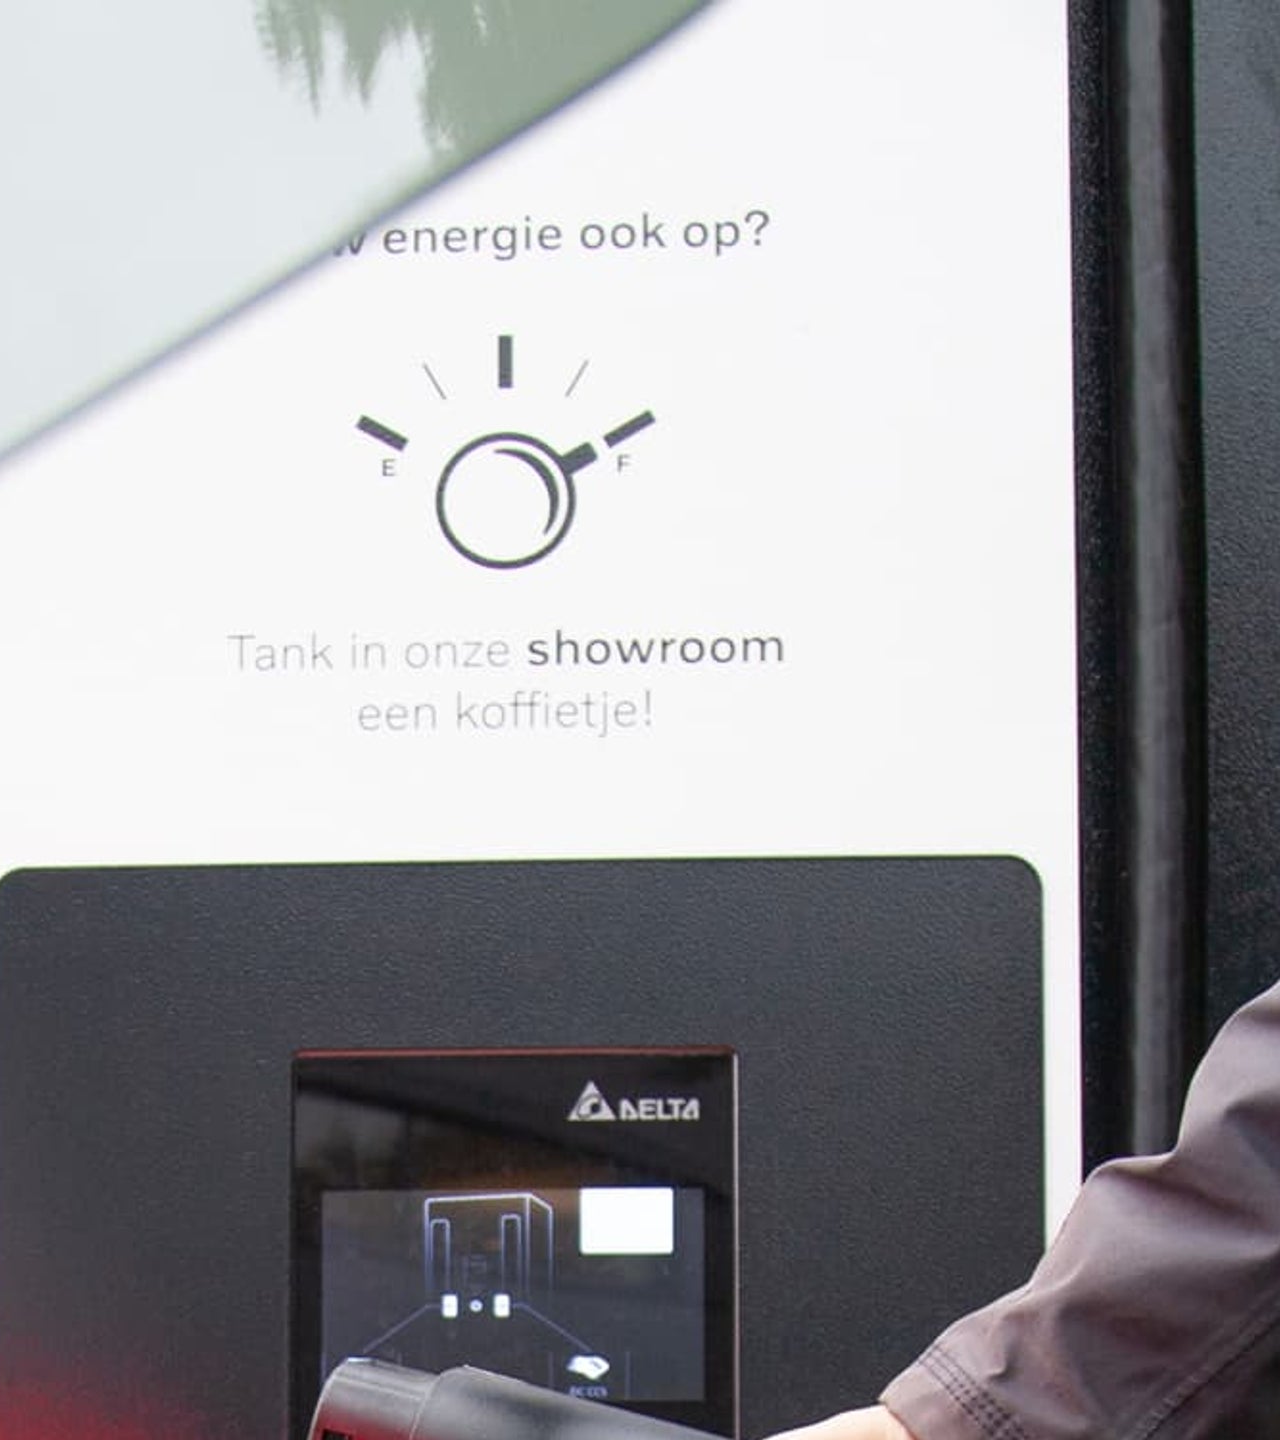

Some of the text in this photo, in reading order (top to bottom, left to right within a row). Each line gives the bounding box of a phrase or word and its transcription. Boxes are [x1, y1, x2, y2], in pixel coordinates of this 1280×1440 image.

[382, 215, 563, 262] energie
[579, 212, 667, 251] ook
[682, 209, 771, 257] op?
[381, 457, 397, 477] E
[616, 453, 632, 474] F
[226, 629, 785, 671] Tank in onze showroom
[357, 690, 652, 738] een koffietje!
[619, 1098, 701, 1121] DELTA
